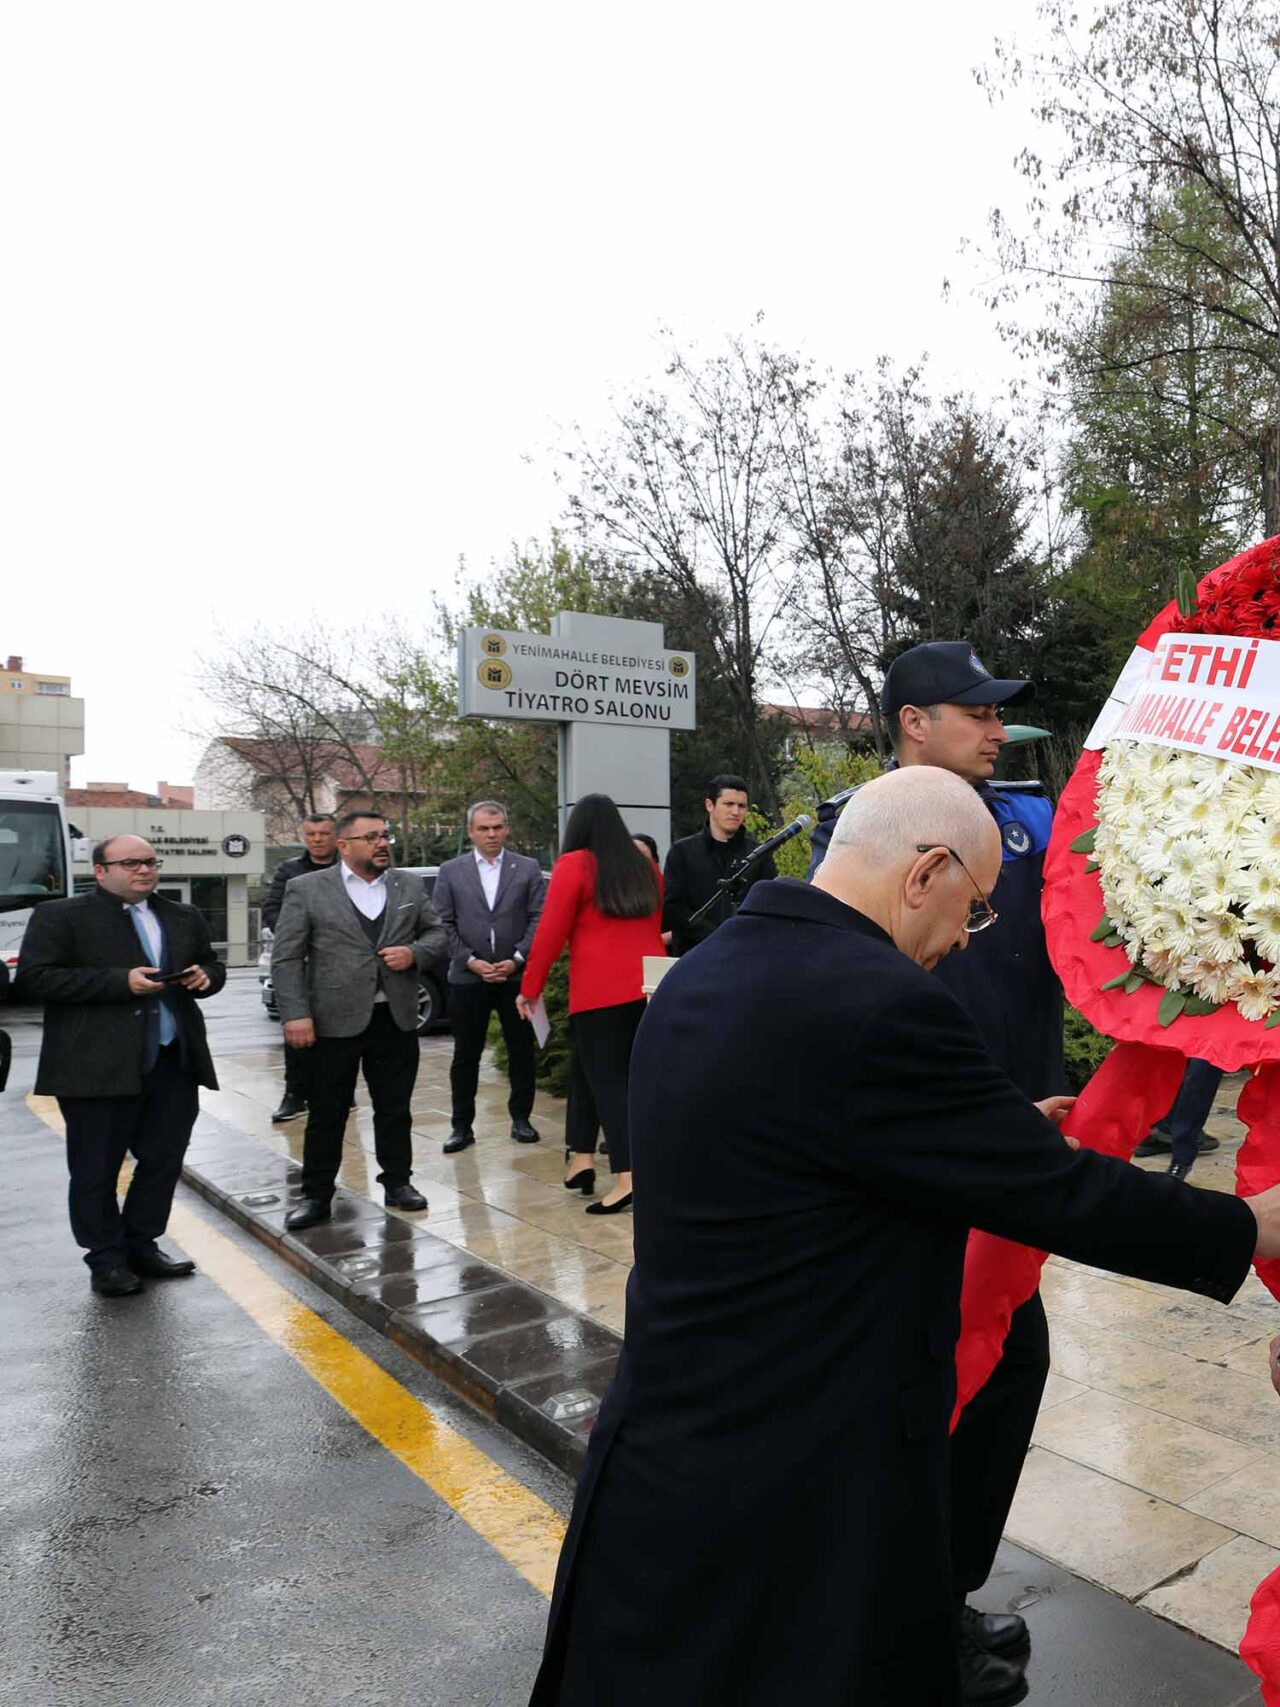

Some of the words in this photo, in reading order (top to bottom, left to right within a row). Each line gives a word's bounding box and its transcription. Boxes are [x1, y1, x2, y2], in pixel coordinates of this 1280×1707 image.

[512, 643, 599, 664] YENİMAHALLE
[601, 654, 666, 671] BELEDİYESİ
[555, 669, 609, 692] DÖRT
[615, 677, 689, 699] MEVSİM
[505, 688, 589, 714] TİYATRO
[594, 701, 671, 721] SALONU
